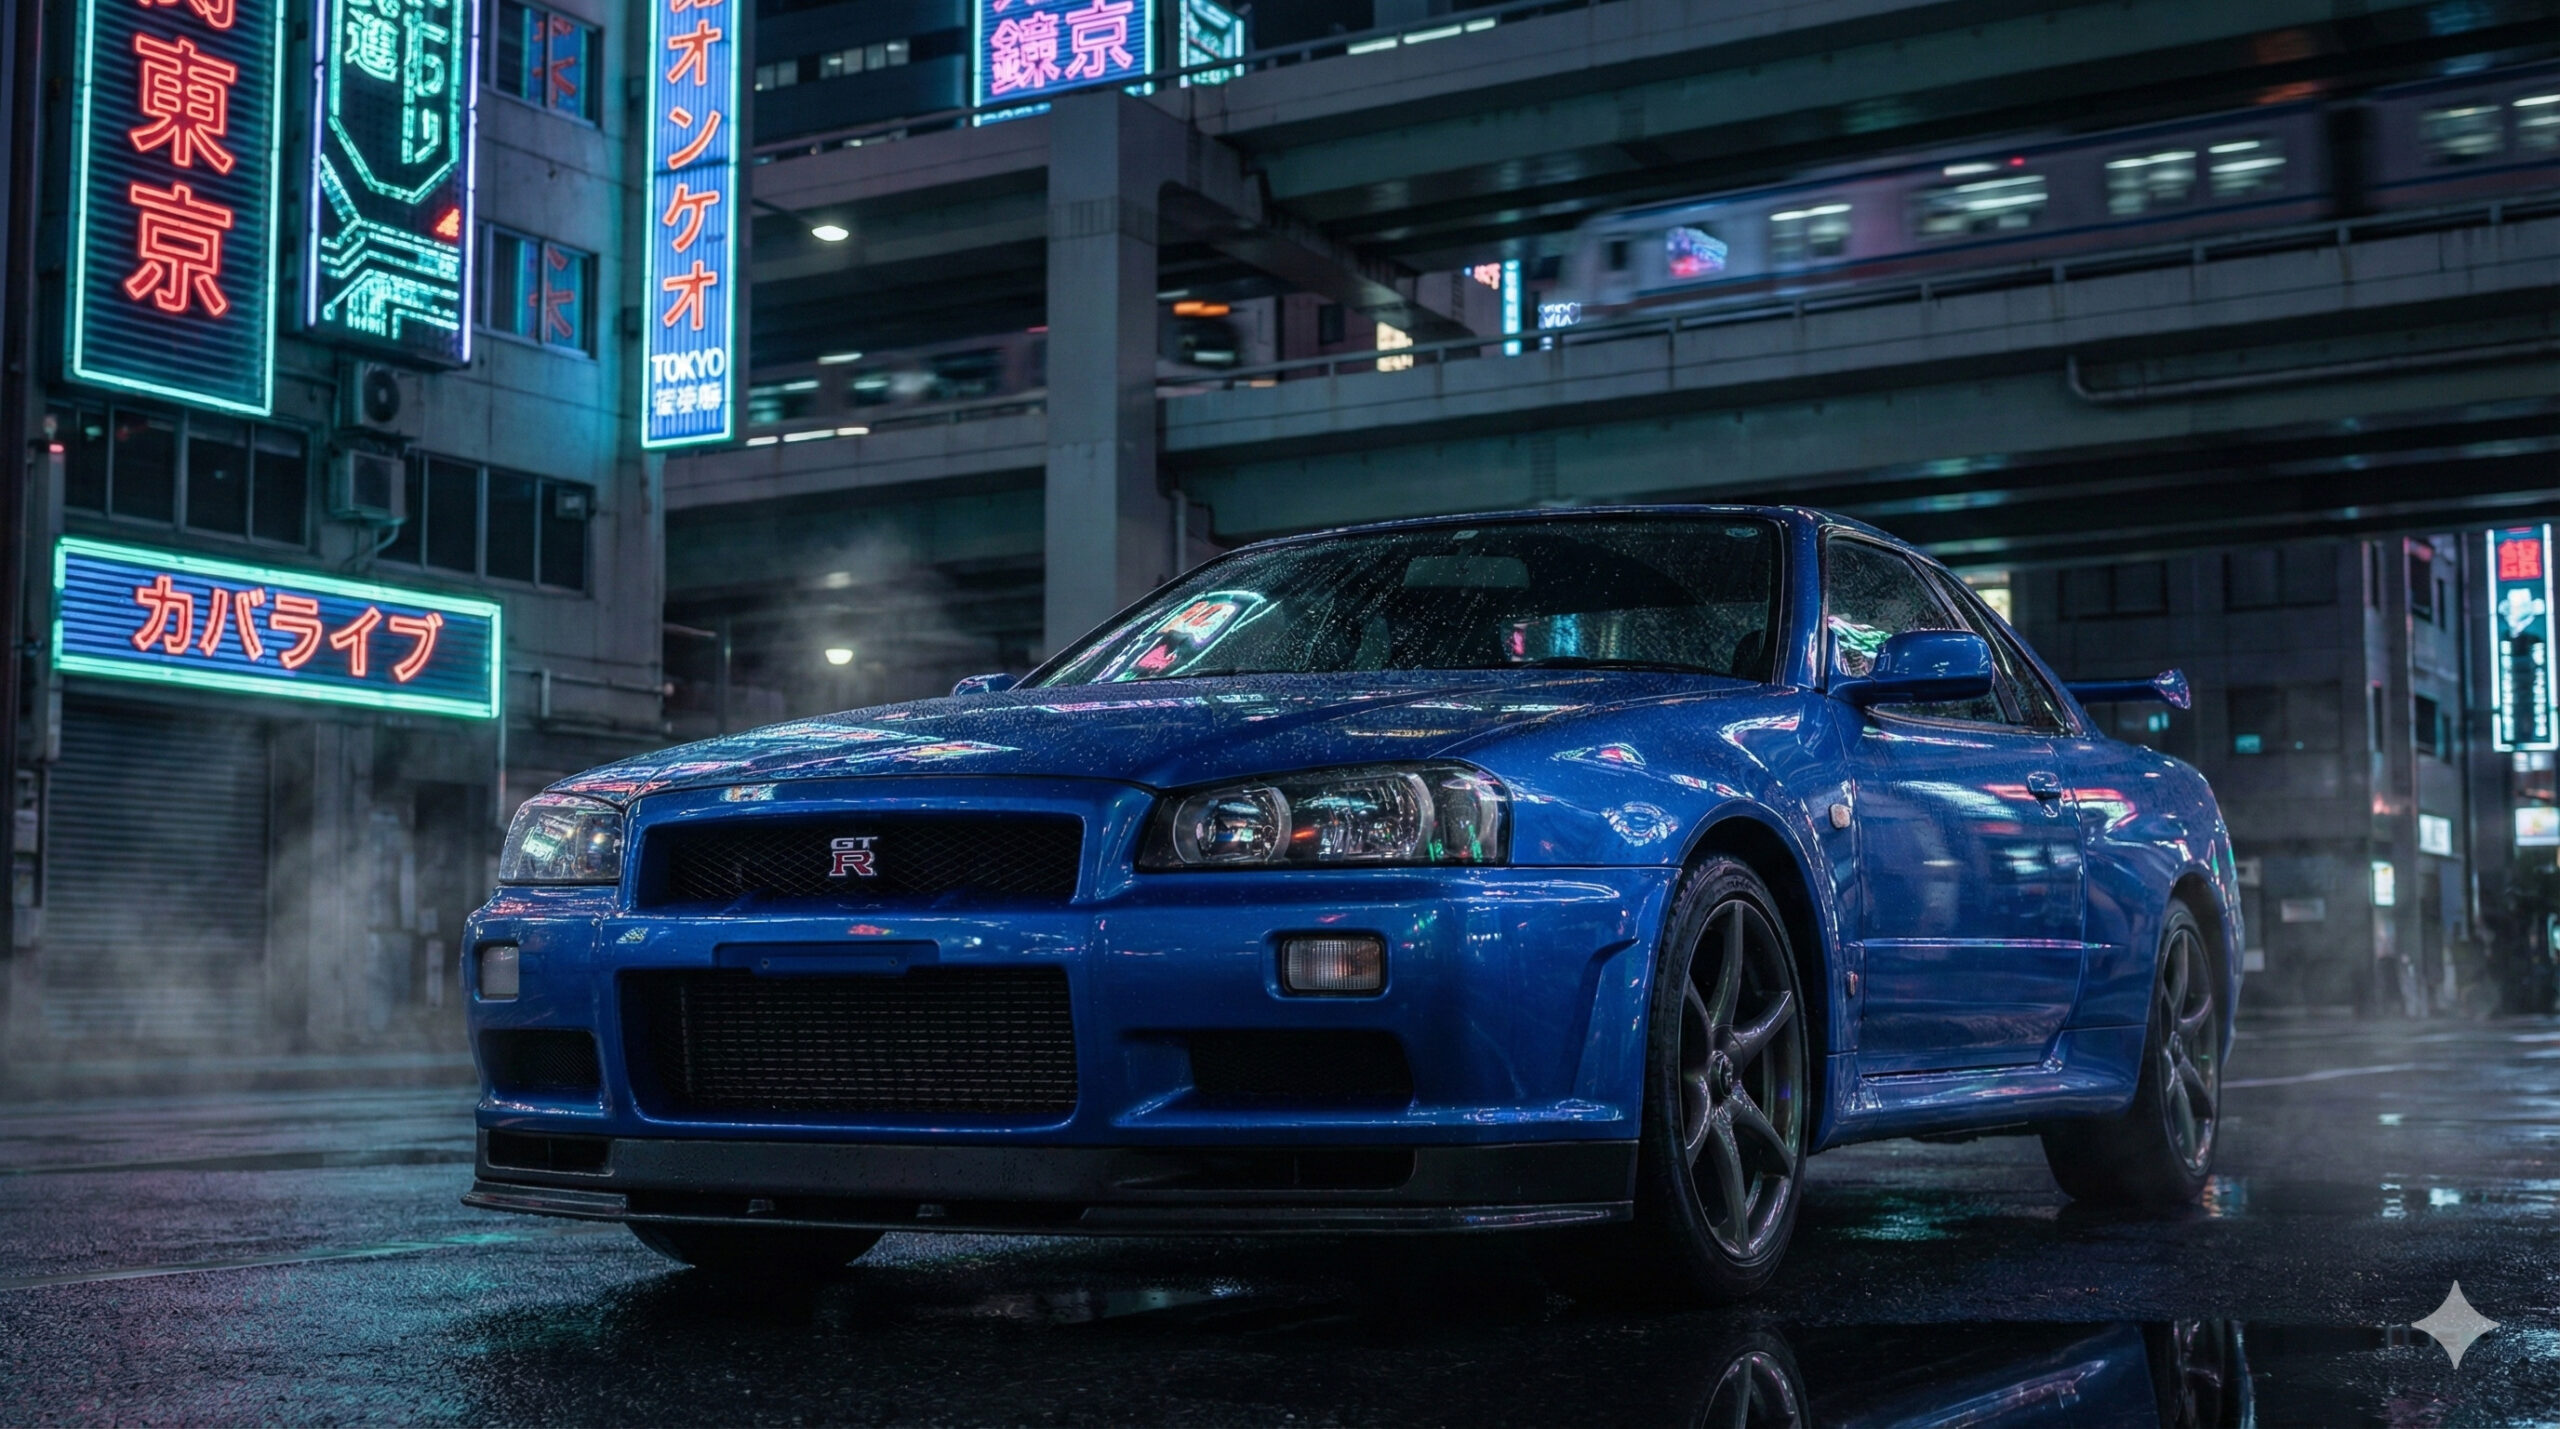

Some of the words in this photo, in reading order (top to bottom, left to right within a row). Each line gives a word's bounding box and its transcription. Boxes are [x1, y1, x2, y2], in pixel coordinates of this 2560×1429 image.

[662, 0, 722, 331] オンケオ
[651, 347, 725, 384] TOKYO
[132, 574, 444, 683] カバライブ
[830, 836, 879, 850] GT
[829, 850, 875, 877] R
